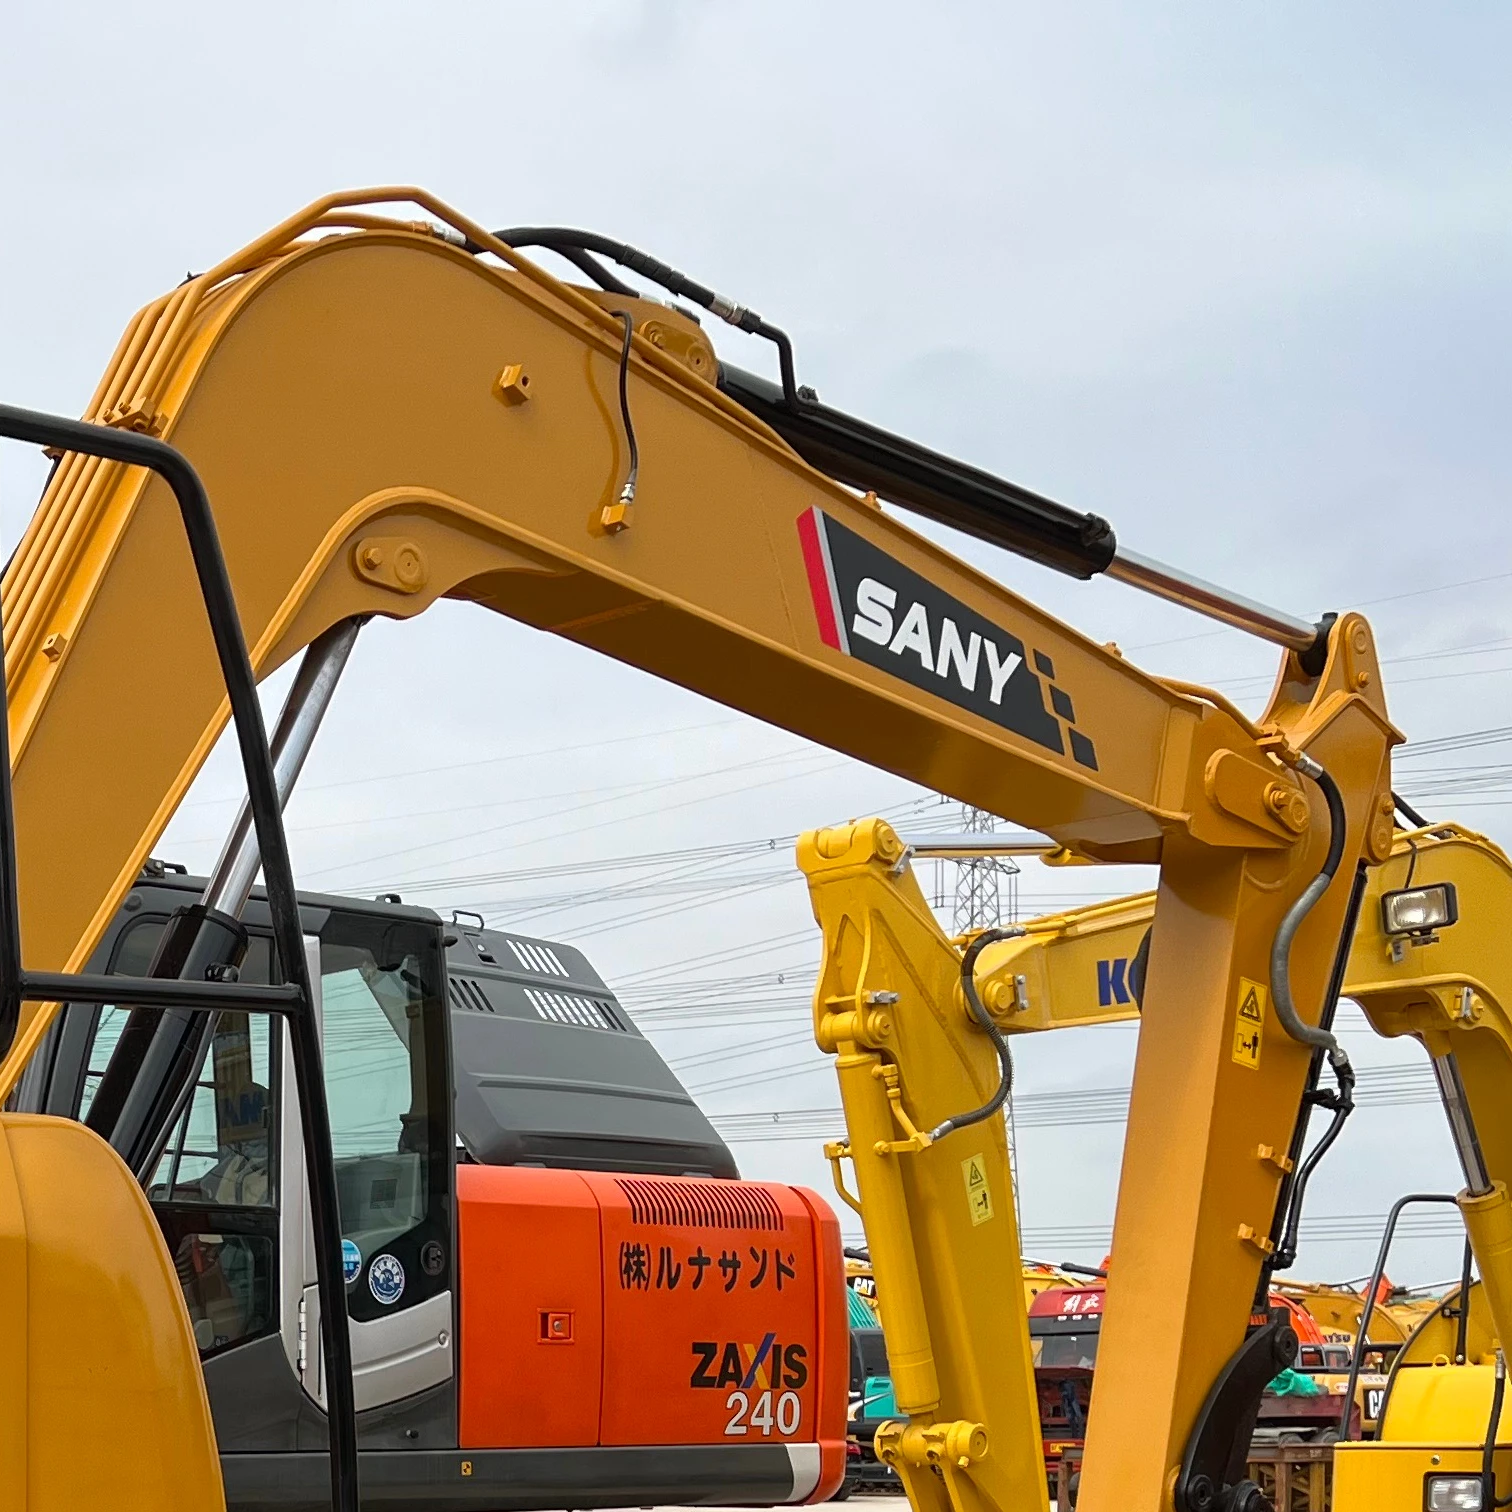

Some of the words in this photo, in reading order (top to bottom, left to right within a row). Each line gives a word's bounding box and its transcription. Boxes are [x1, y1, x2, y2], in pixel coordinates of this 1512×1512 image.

[852, 577, 1023, 705] SANY
[618, 1241, 796, 1293] (株)ルナサンド
[690, 1332, 808, 1390] ZAXIS
[724, 1390, 802, 1436] 240
